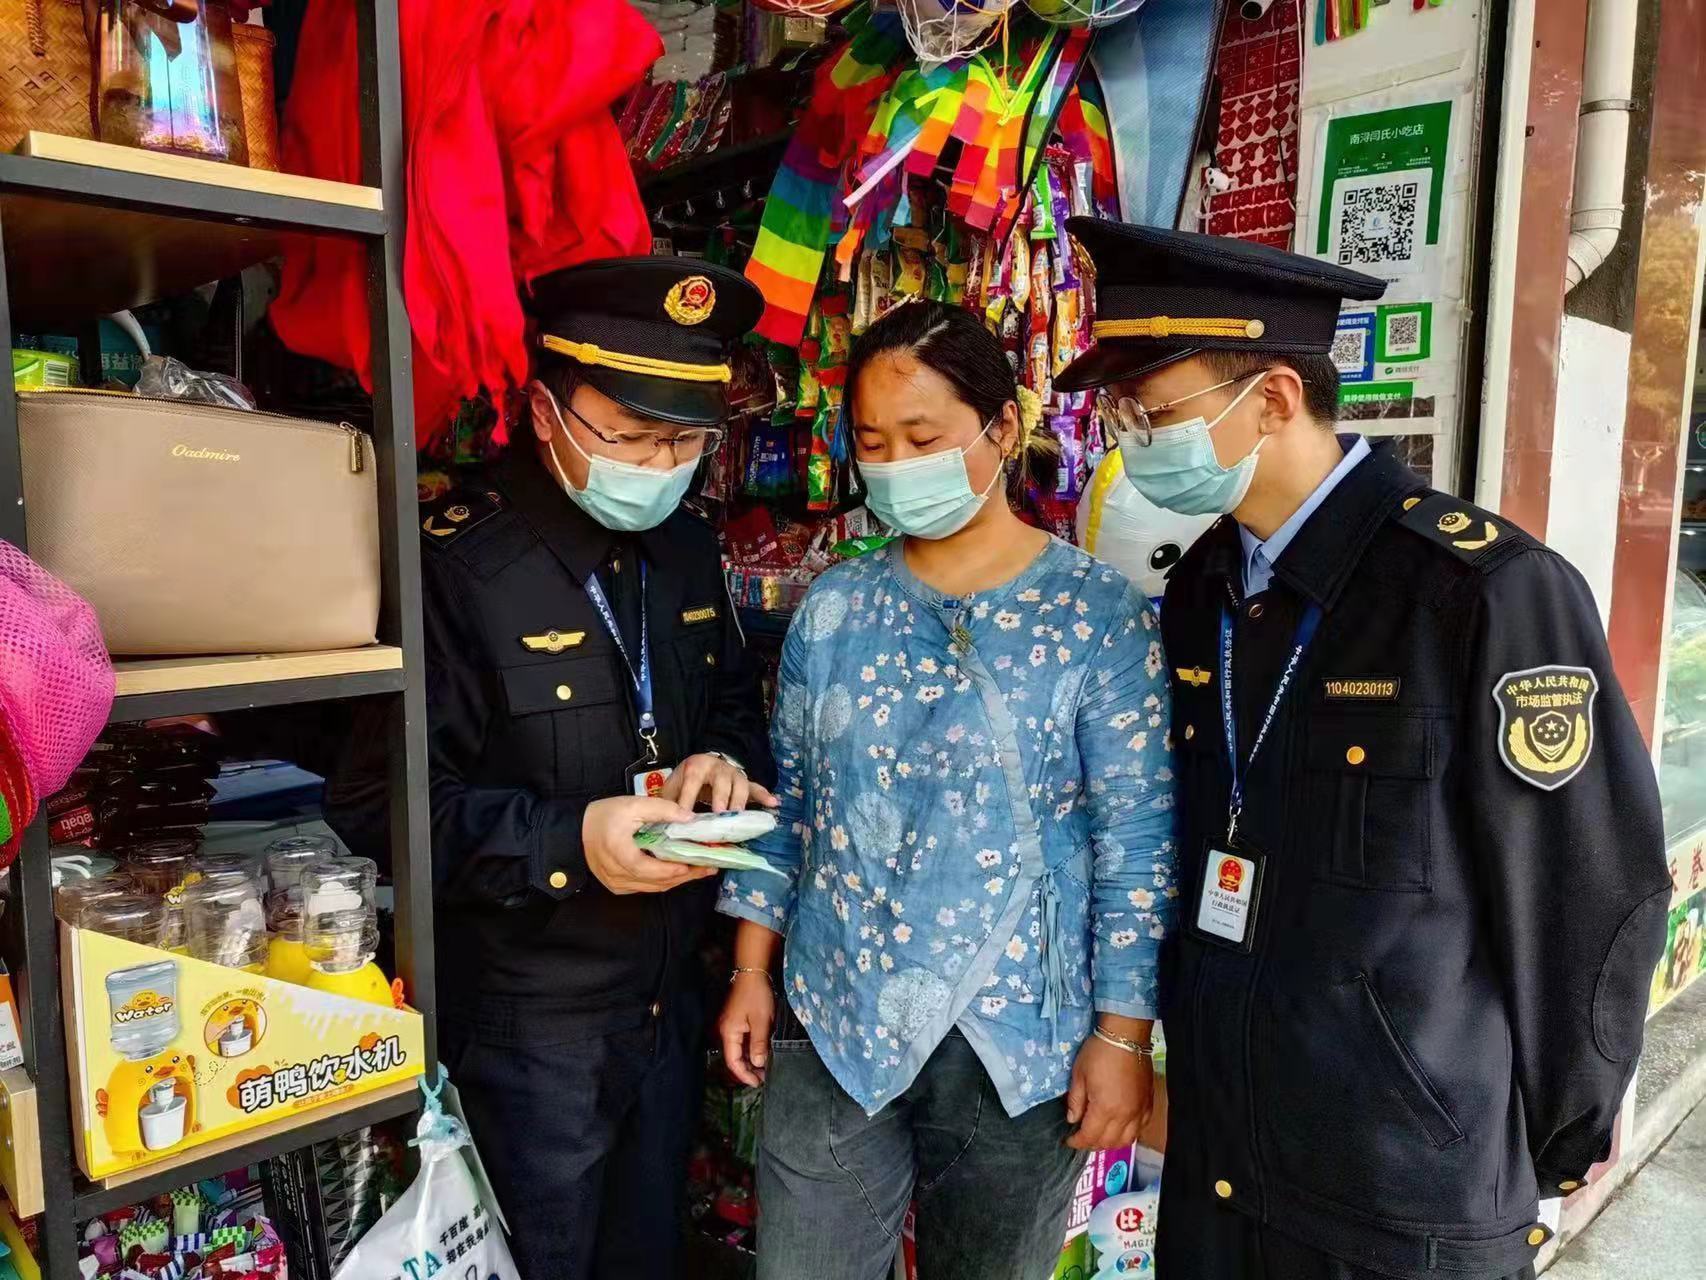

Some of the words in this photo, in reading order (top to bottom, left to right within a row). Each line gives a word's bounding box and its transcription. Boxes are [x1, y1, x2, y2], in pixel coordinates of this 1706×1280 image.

[171, 443, 241, 462] Oadmire
[1325, 681, 1394, 696] 11040230113
[1506, 675, 1590, 696] 中华人民共和国
[1515, 691, 1583, 708] 市场监管执法
[115, 1002, 174, 1023] Water
[239, 1035, 406, 1113] 萌鸭饮水机
